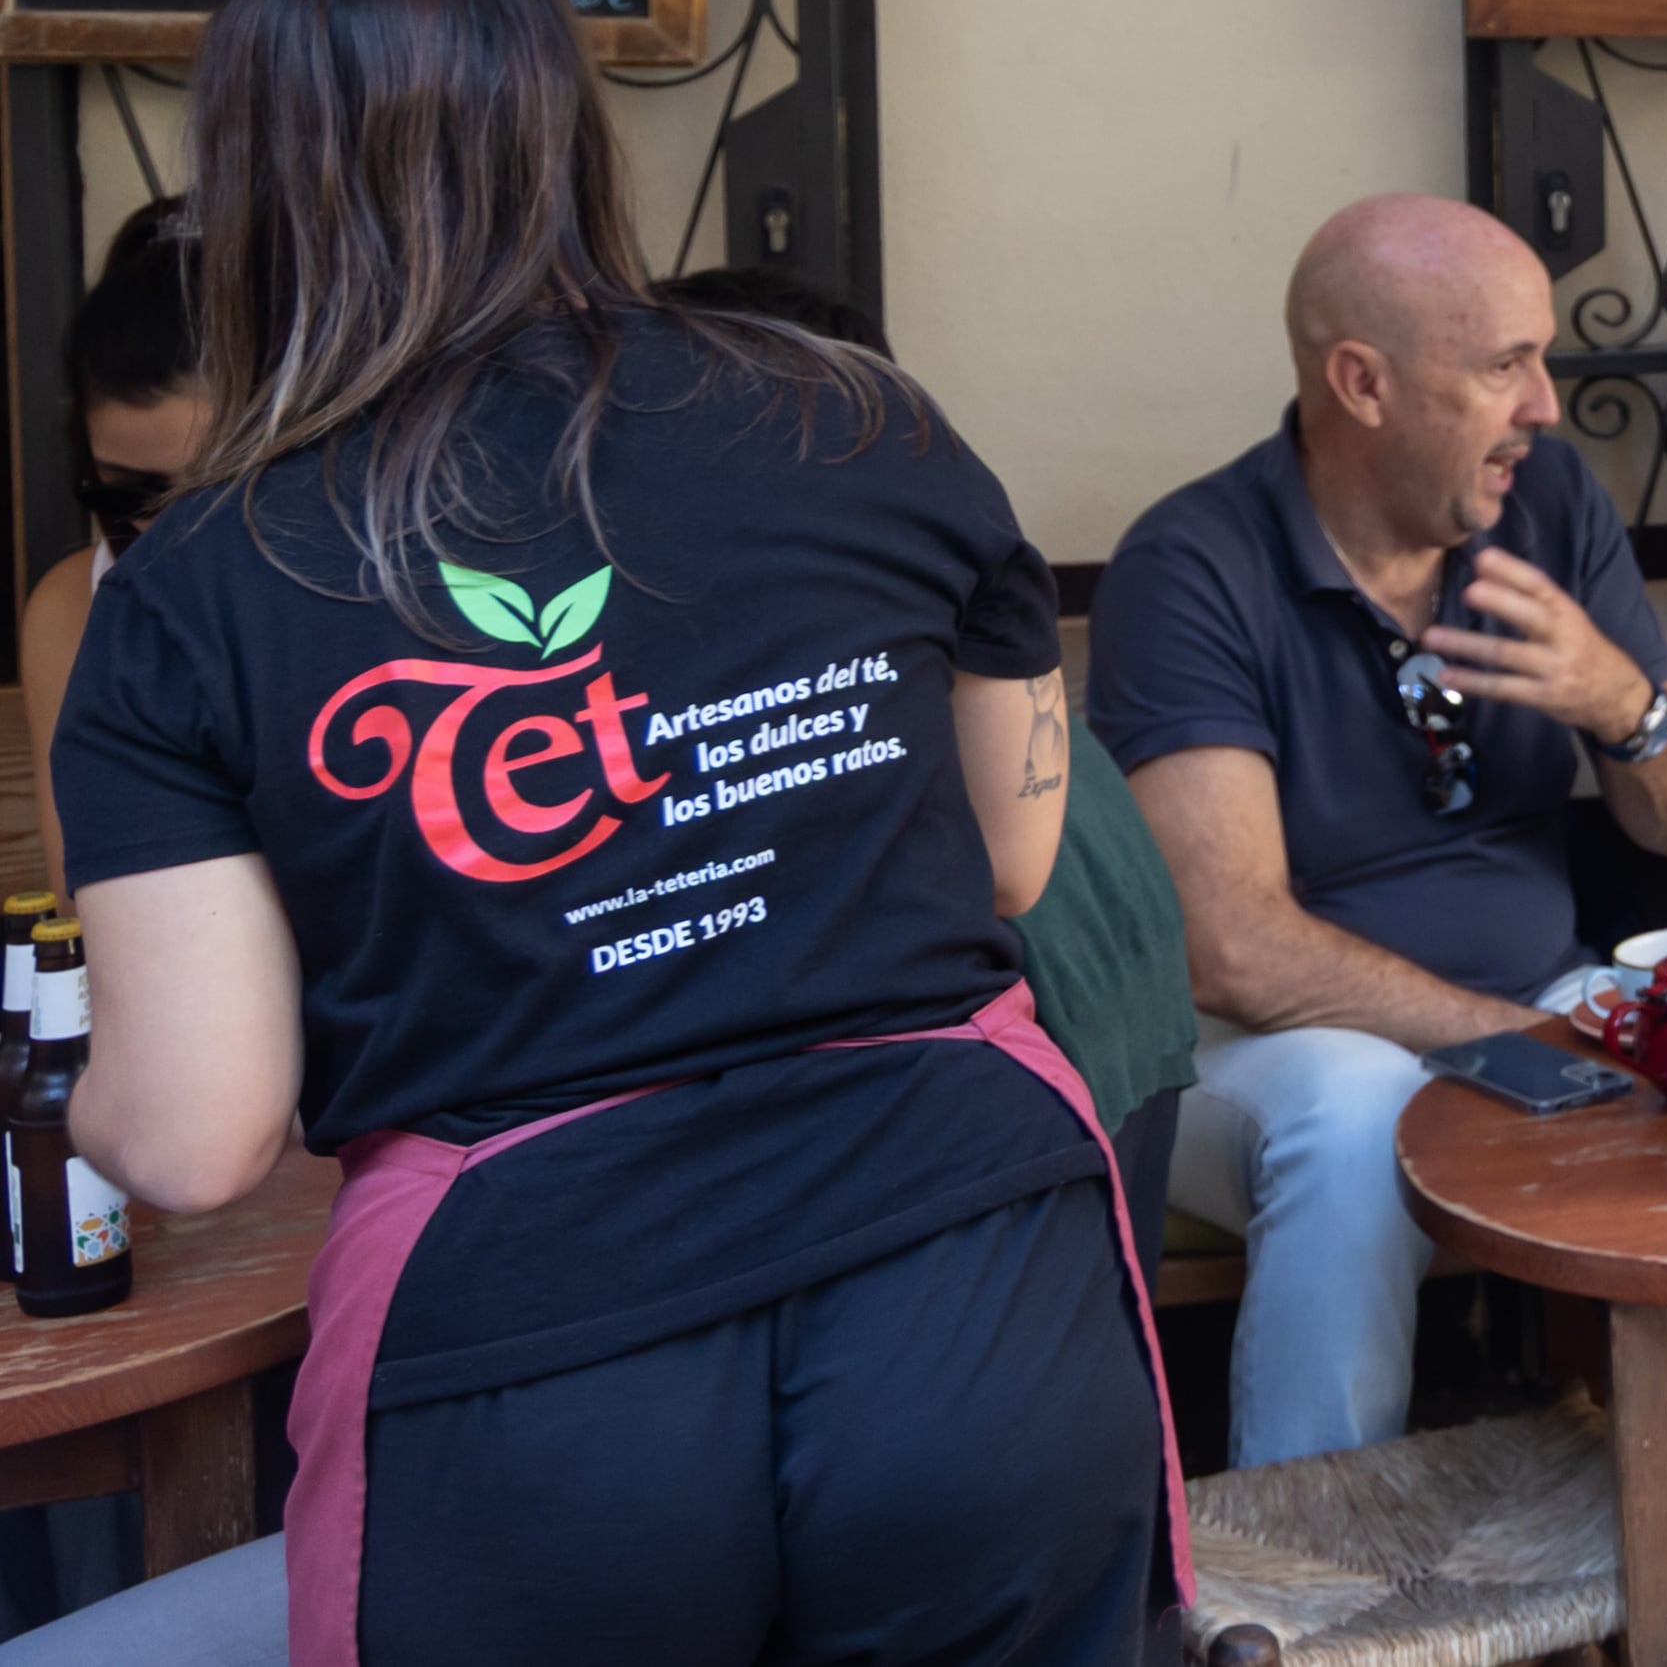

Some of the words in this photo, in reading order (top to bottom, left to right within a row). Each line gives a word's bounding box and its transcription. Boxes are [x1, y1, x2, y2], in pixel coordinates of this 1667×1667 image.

[645, 676, 813, 747] Artesanos
[814, 657, 861, 695] del
[861, 651, 899, 685] té,
[696, 738, 746, 774] los
[749, 709, 846, 757] dulces
[848, 703, 870, 733] y
[308, 642, 672, 883] Tet
[662, 793, 712, 828] los
[714, 757, 828, 811] buenos
[832, 736, 909, 777] ratos.
[564, 847, 777, 925] www.la-teteria.com
[590, 919, 696, 974] DESDE
[697, 895, 768, 941] 1993
